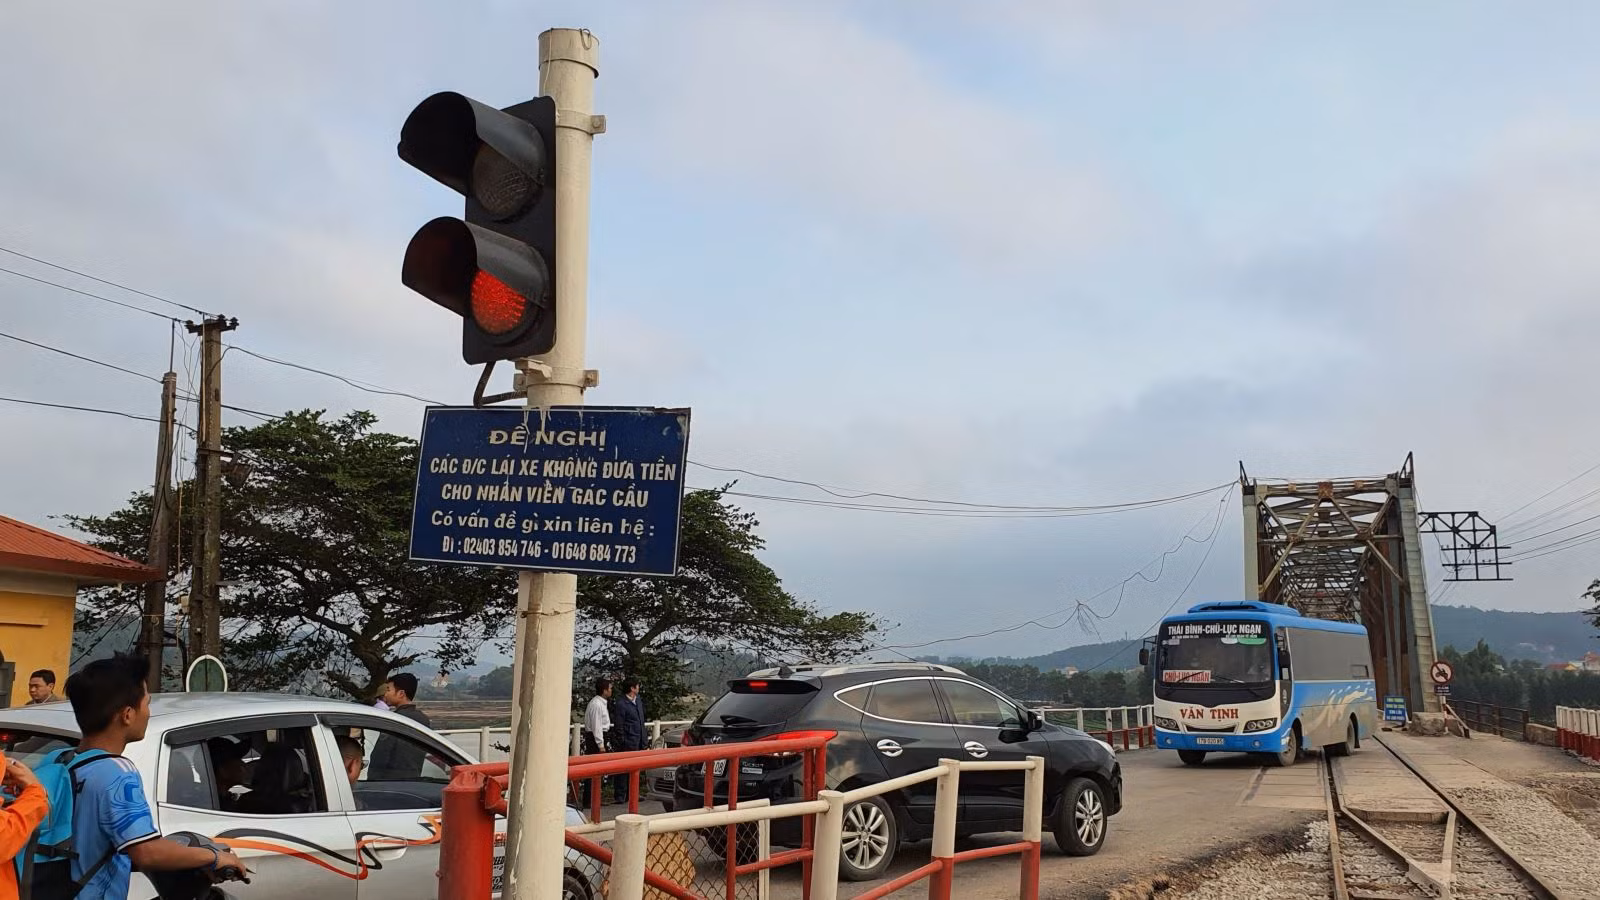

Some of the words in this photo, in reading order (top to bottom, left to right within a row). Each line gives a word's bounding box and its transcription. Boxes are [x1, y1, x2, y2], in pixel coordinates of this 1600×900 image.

[534, 430, 607, 452] NGHỊ
[430, 453, 459, 474] CÁC
[491, 454, 516, 476] LÁI
[518, 459, 540, 476] XE
[543, 456, 598, 479] KHÔNG
[602, 460, 635, 480] ĐƯA
[640, 455, 677, 481] TIỀN
[441, 483, 472, 501] CHO
[571, 483, 607, 505] GÁC
[612, 483, 649, 508] CẦU
[431, 510, 454, 527] Có
[458, 508, 489, 528] vấn
[494, 510, 517, 530] đề
[521, 512, 539, 534] gì
[543, 516, 573, 532] xin
[577, 516, 614, 534] liên
[620, 518, 645, 540] hệ
[463, 537, 495, 555] 02403
[498, 539, 518, 557] 854
[520, 540, 542, 558] 746
[551, 541, 587, 561] 01648
[589, 543, 611, 562] 684
[614, 545, 637, 564] 773
[1168, 624, 1184, 636] THÁI
[1179, 707, 1204, 720] VĂN
[1209, 708, 1239, 722] TỊNH
